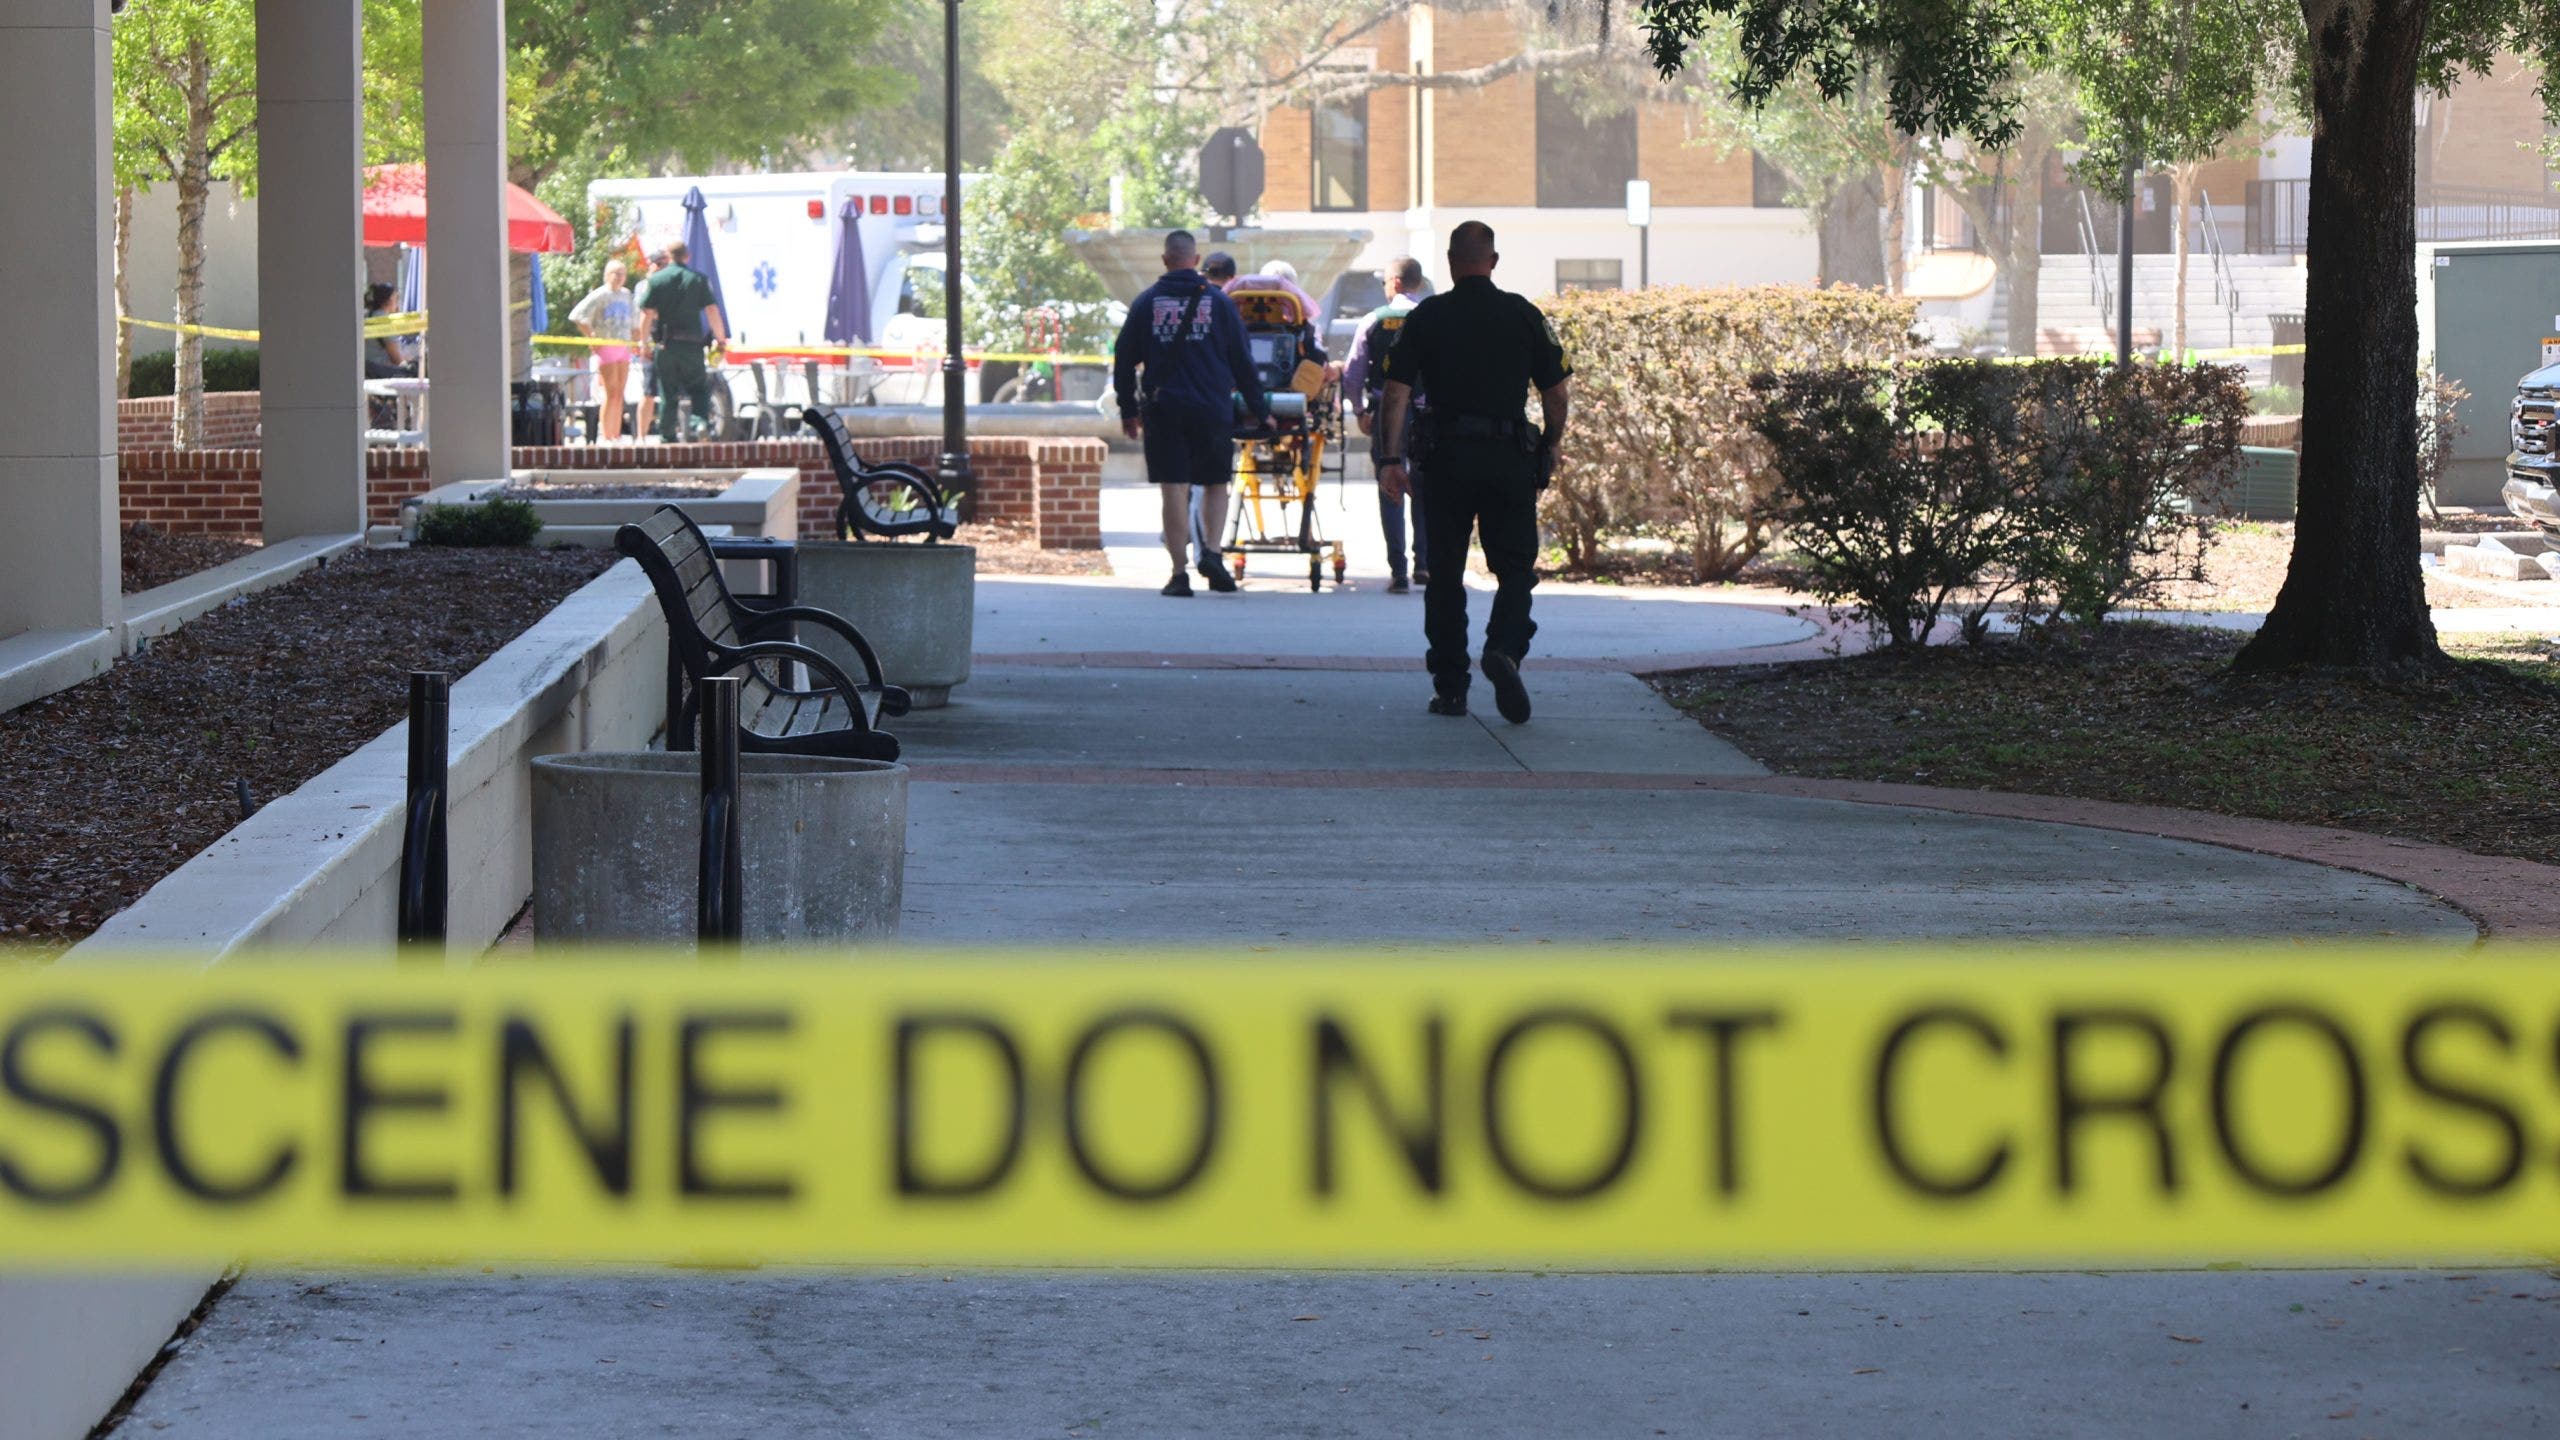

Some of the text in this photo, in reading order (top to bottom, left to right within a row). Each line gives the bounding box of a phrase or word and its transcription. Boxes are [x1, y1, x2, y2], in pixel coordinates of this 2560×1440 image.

[1153, 323, 1210, 335] RESUE
[0, 1002, 2560, 1208] SCENE DO NOT CROS
